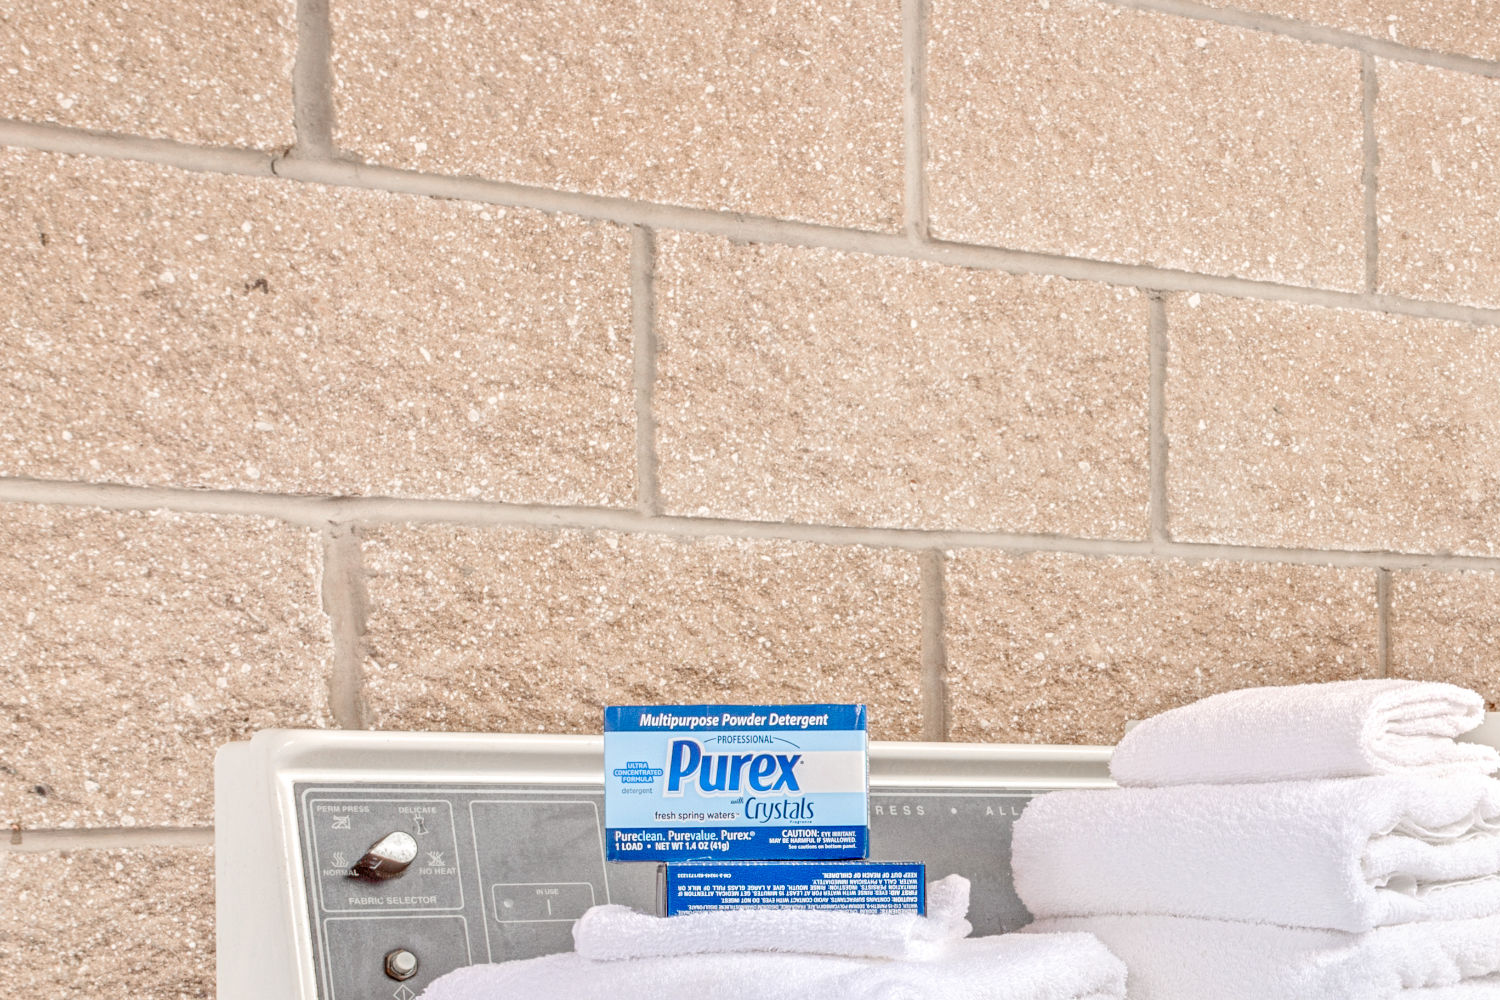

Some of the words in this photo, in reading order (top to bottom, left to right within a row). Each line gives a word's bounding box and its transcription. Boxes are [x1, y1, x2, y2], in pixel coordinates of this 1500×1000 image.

[639, 713, 720, 730] Multipurpose
[721, 712, 767, 727] Powder
[768, 712, 829, 729] Detergent
[717, 735, 774, 744] PROFESSIONAL
[667, 740, 802, 792] Purex
[621, 787, 653, 795] detergent
[316, 805, 341, 813] PERM
[342, 805, 370, 813] PRESS
[398, 806, 437, 814] DELICATE
[745, 796, 815, 823] Crystals
[875, 805, 925, 816] RESS
[985, 805, 1019, 816] ALL
[654, 811, 676, 820] fresh
[678, 811, 705, 821] spring
[615, 830, 666, 842] Pureclean.
[668, 830, 719, 841] Purevalue.
[781, 829, 820, 838] CAUTION:
[615, 843, 620, 851] 1
[621, 842, 644, 851] LOAD
[655, 842, 670, 851] NET
[671, 842, 684, 850] WT
[685, 842, 697, 850] 1.4
[698, 842, 709, 850] OZ
[710, 841, 730, 852] (41g)
[322, 869, 360, 877] NORMAL
[419, 867, 433, 875] NO
[434, 867, 456, 875] HEAT
[348, 897, 384, 905] FABRIC
[386, 896, 437, 904] SELECTOR
